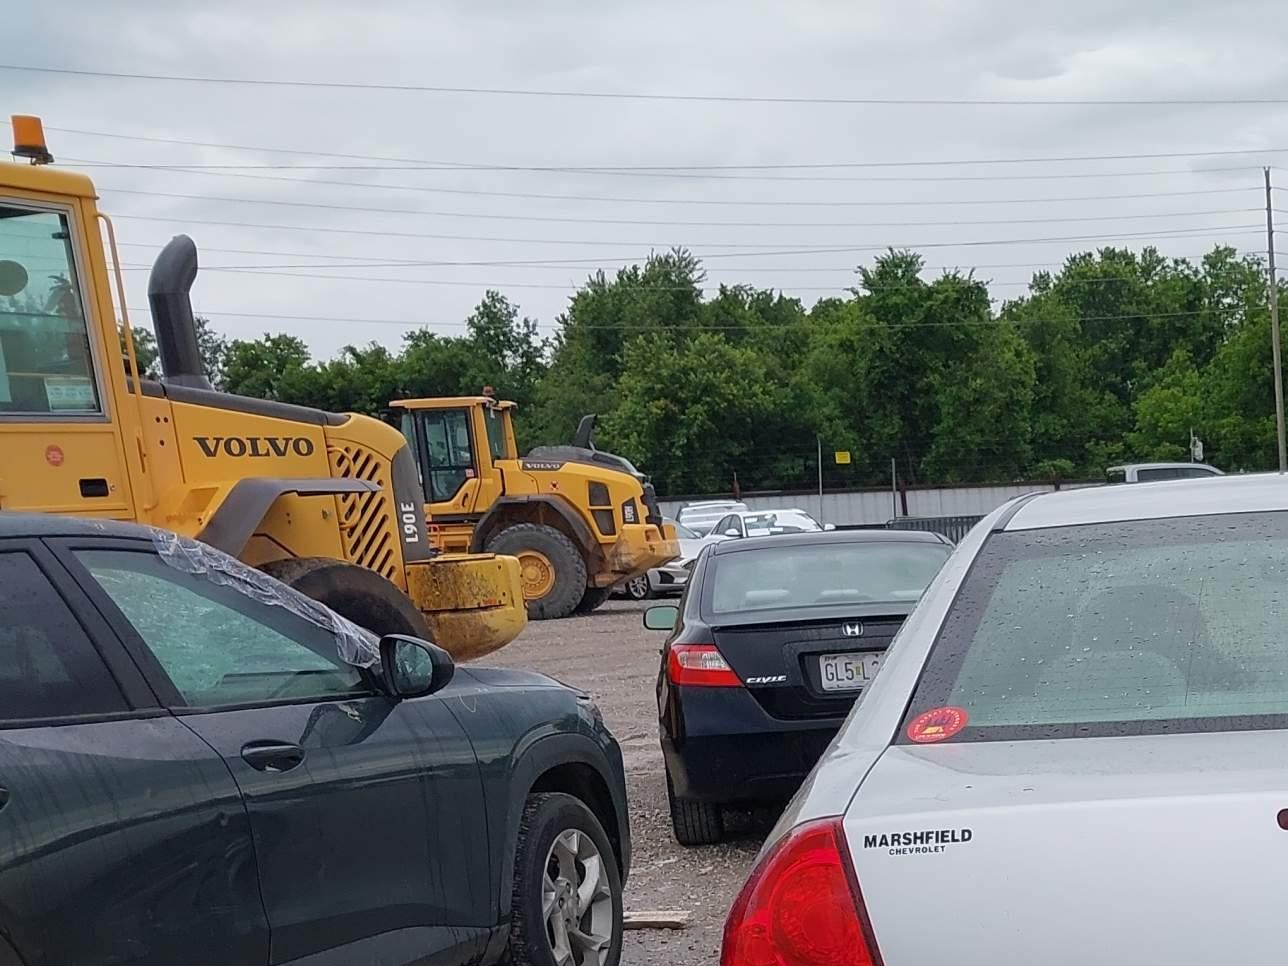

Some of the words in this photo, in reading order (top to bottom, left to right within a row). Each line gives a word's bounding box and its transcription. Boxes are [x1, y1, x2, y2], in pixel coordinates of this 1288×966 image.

[192, 437, 314, 457] VOLVO
[401, 503, 418, 542] L90E
[746, 675, 787, 683] CIVIC
[825, 662, 855, 681] GL5
[864, 829, 972, 848] MARSHFIELD
[889, 845, 946, 855] CHEVROLET
